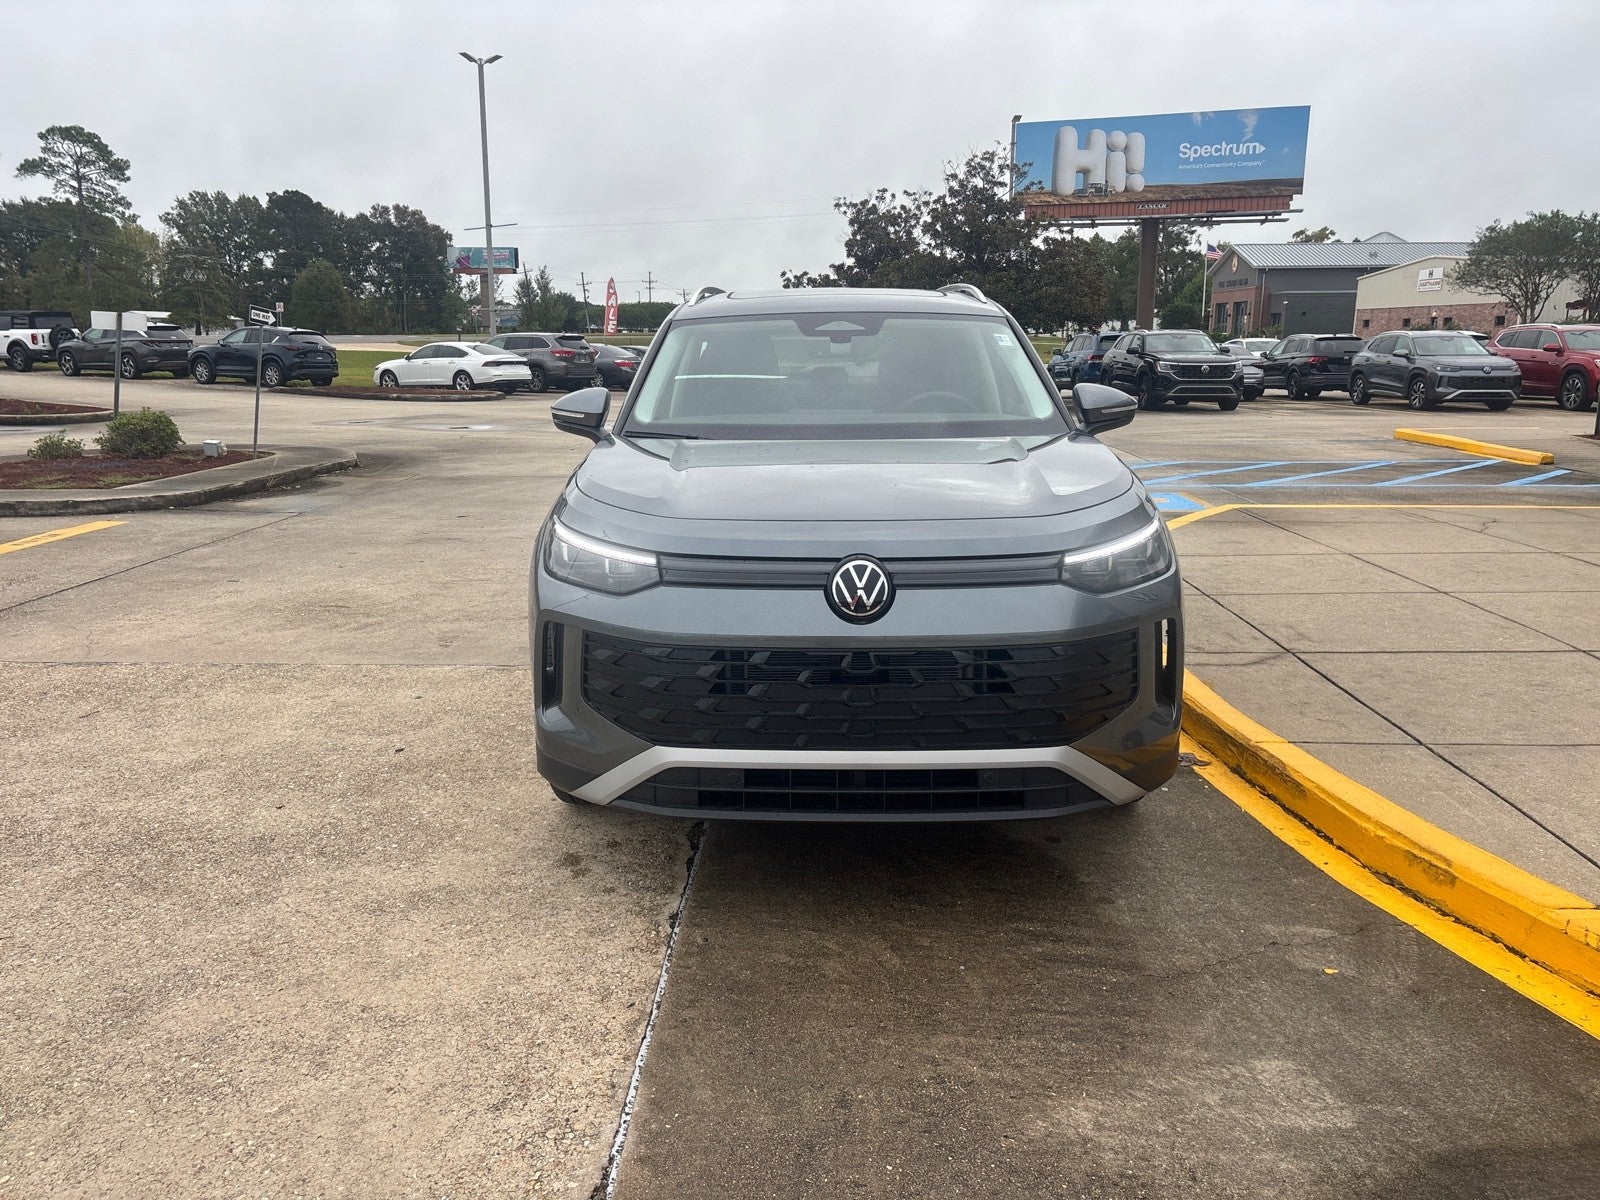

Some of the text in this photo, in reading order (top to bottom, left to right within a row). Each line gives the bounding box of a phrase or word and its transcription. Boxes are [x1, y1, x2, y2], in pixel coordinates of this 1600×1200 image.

[1051, 126, 1146, 196] Hi!
[1179, 141, 1262, 161] Spectrum
[1204, 161, 1236, 169] Connectivity
[1237, 160, 1262, 168] Company
[252, 311, 261, 319] ONE
[607, 281, 617, 333] SALE
